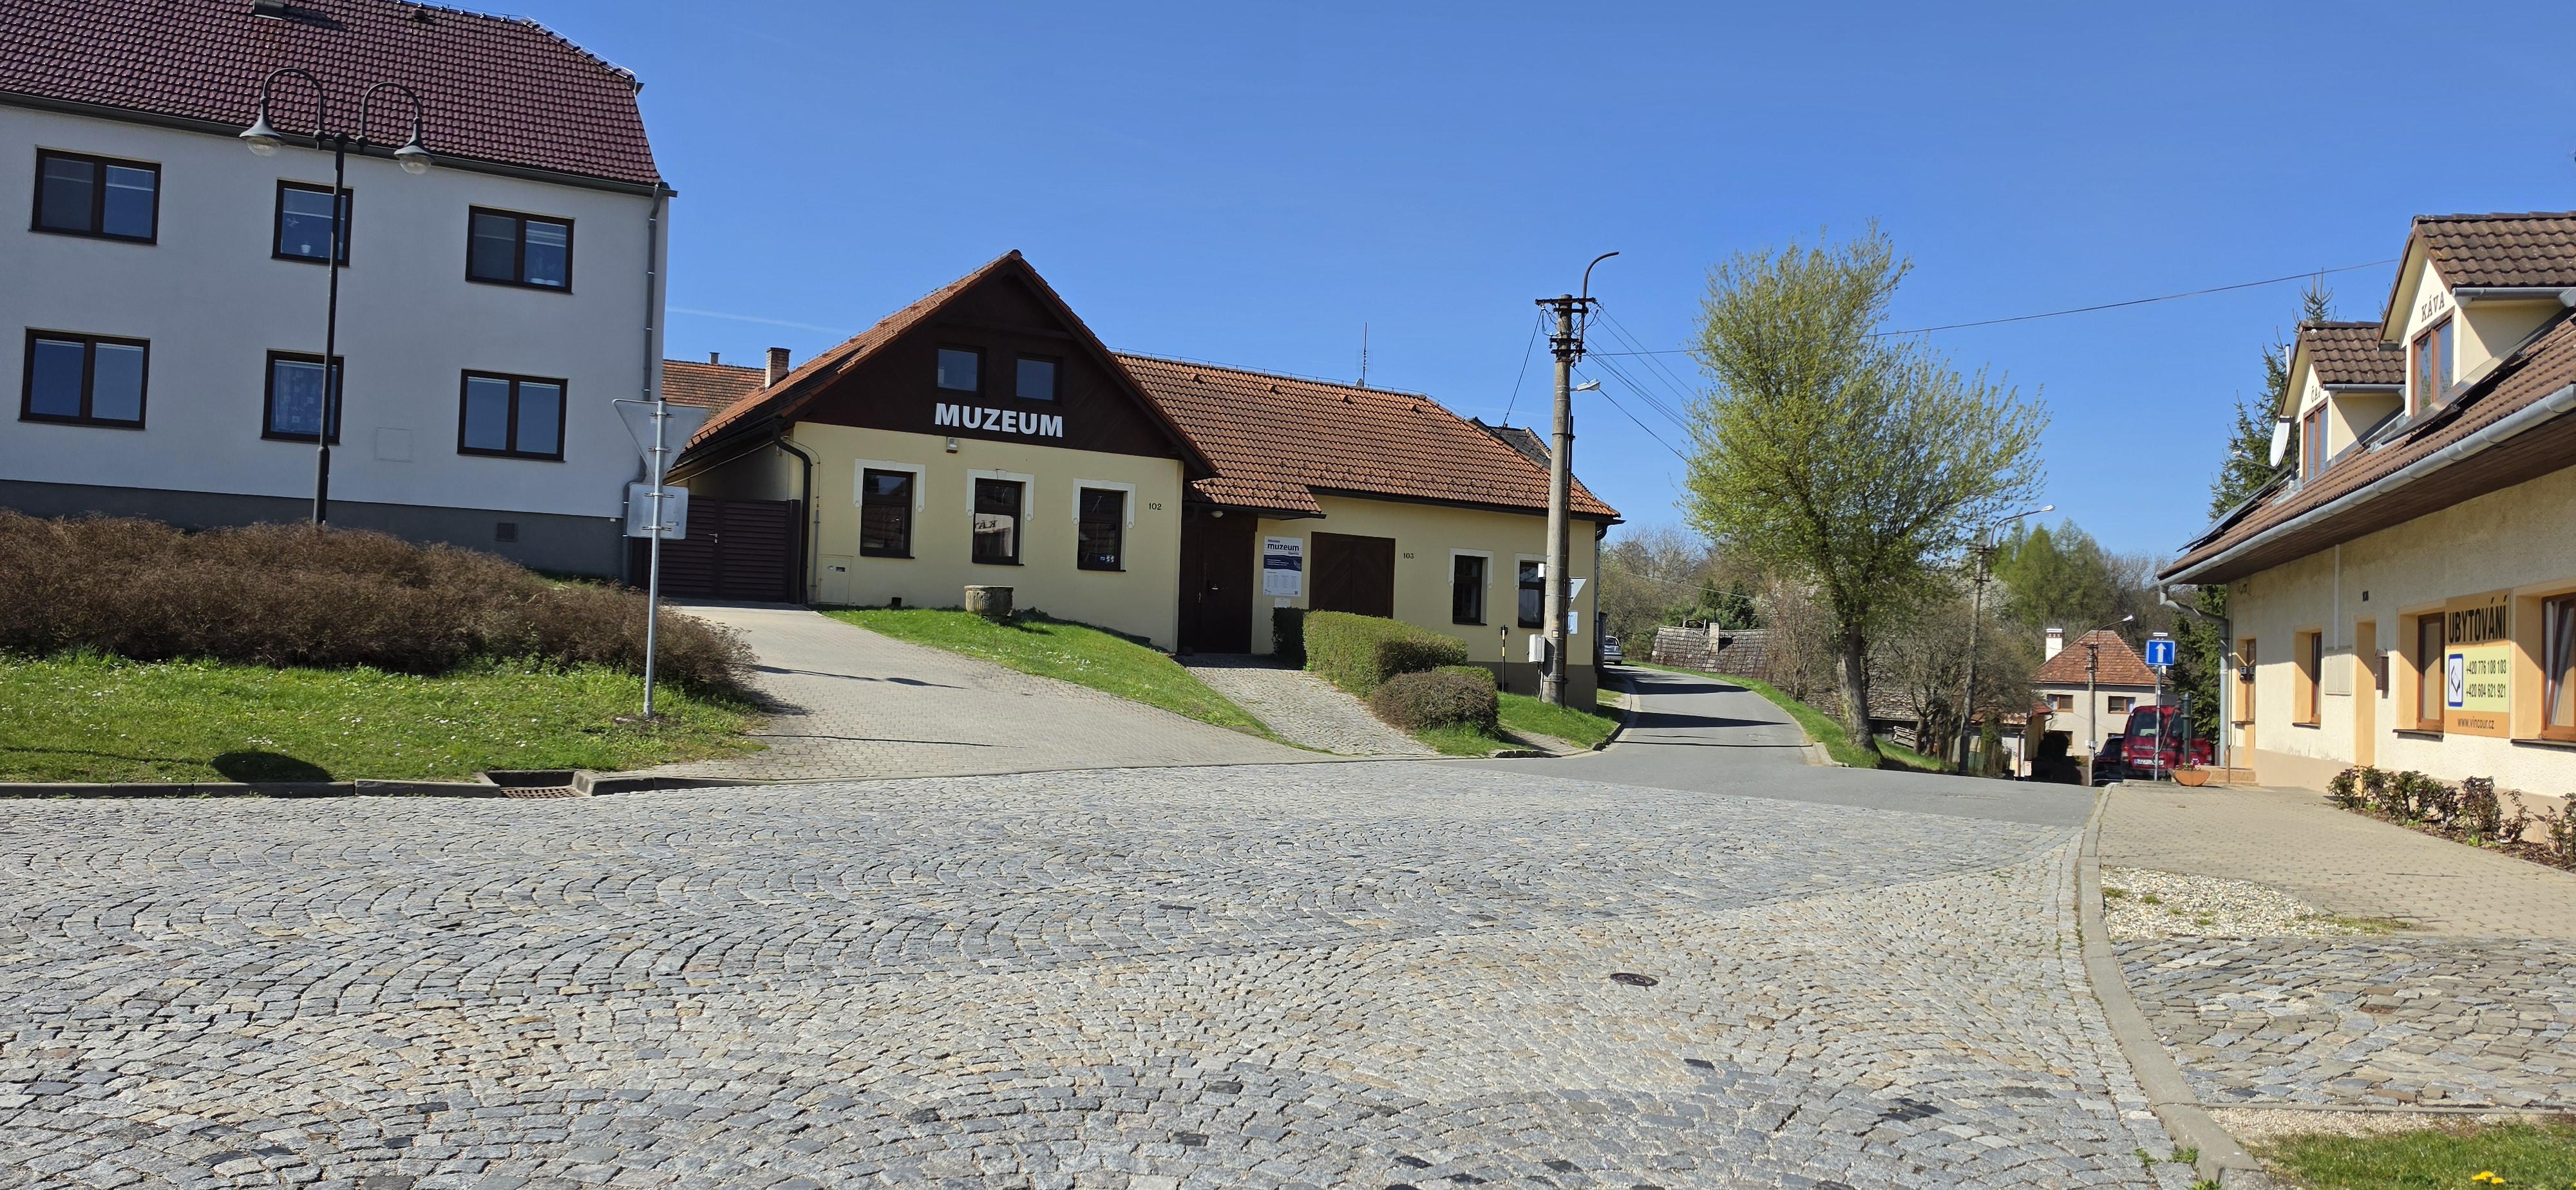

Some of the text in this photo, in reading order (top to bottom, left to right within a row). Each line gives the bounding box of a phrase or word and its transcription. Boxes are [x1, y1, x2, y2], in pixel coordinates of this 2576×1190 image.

[2421, 291, 2445, 323] KÁVA
[934, 402, 1063, 437] MUZEUM
[1149, 502, 1162, 511] 102
[2448, 594, 2507, 643] UBYTOVÁNÍ
[2466, 661, 2477, 675] +420
[2497, 659, 2506, 674] 103
[2466, 683, 2477, 697] +420
[2497, 683, 2506, 698] 921
[2457, 716, 2494, 730] www.vincour.cz
